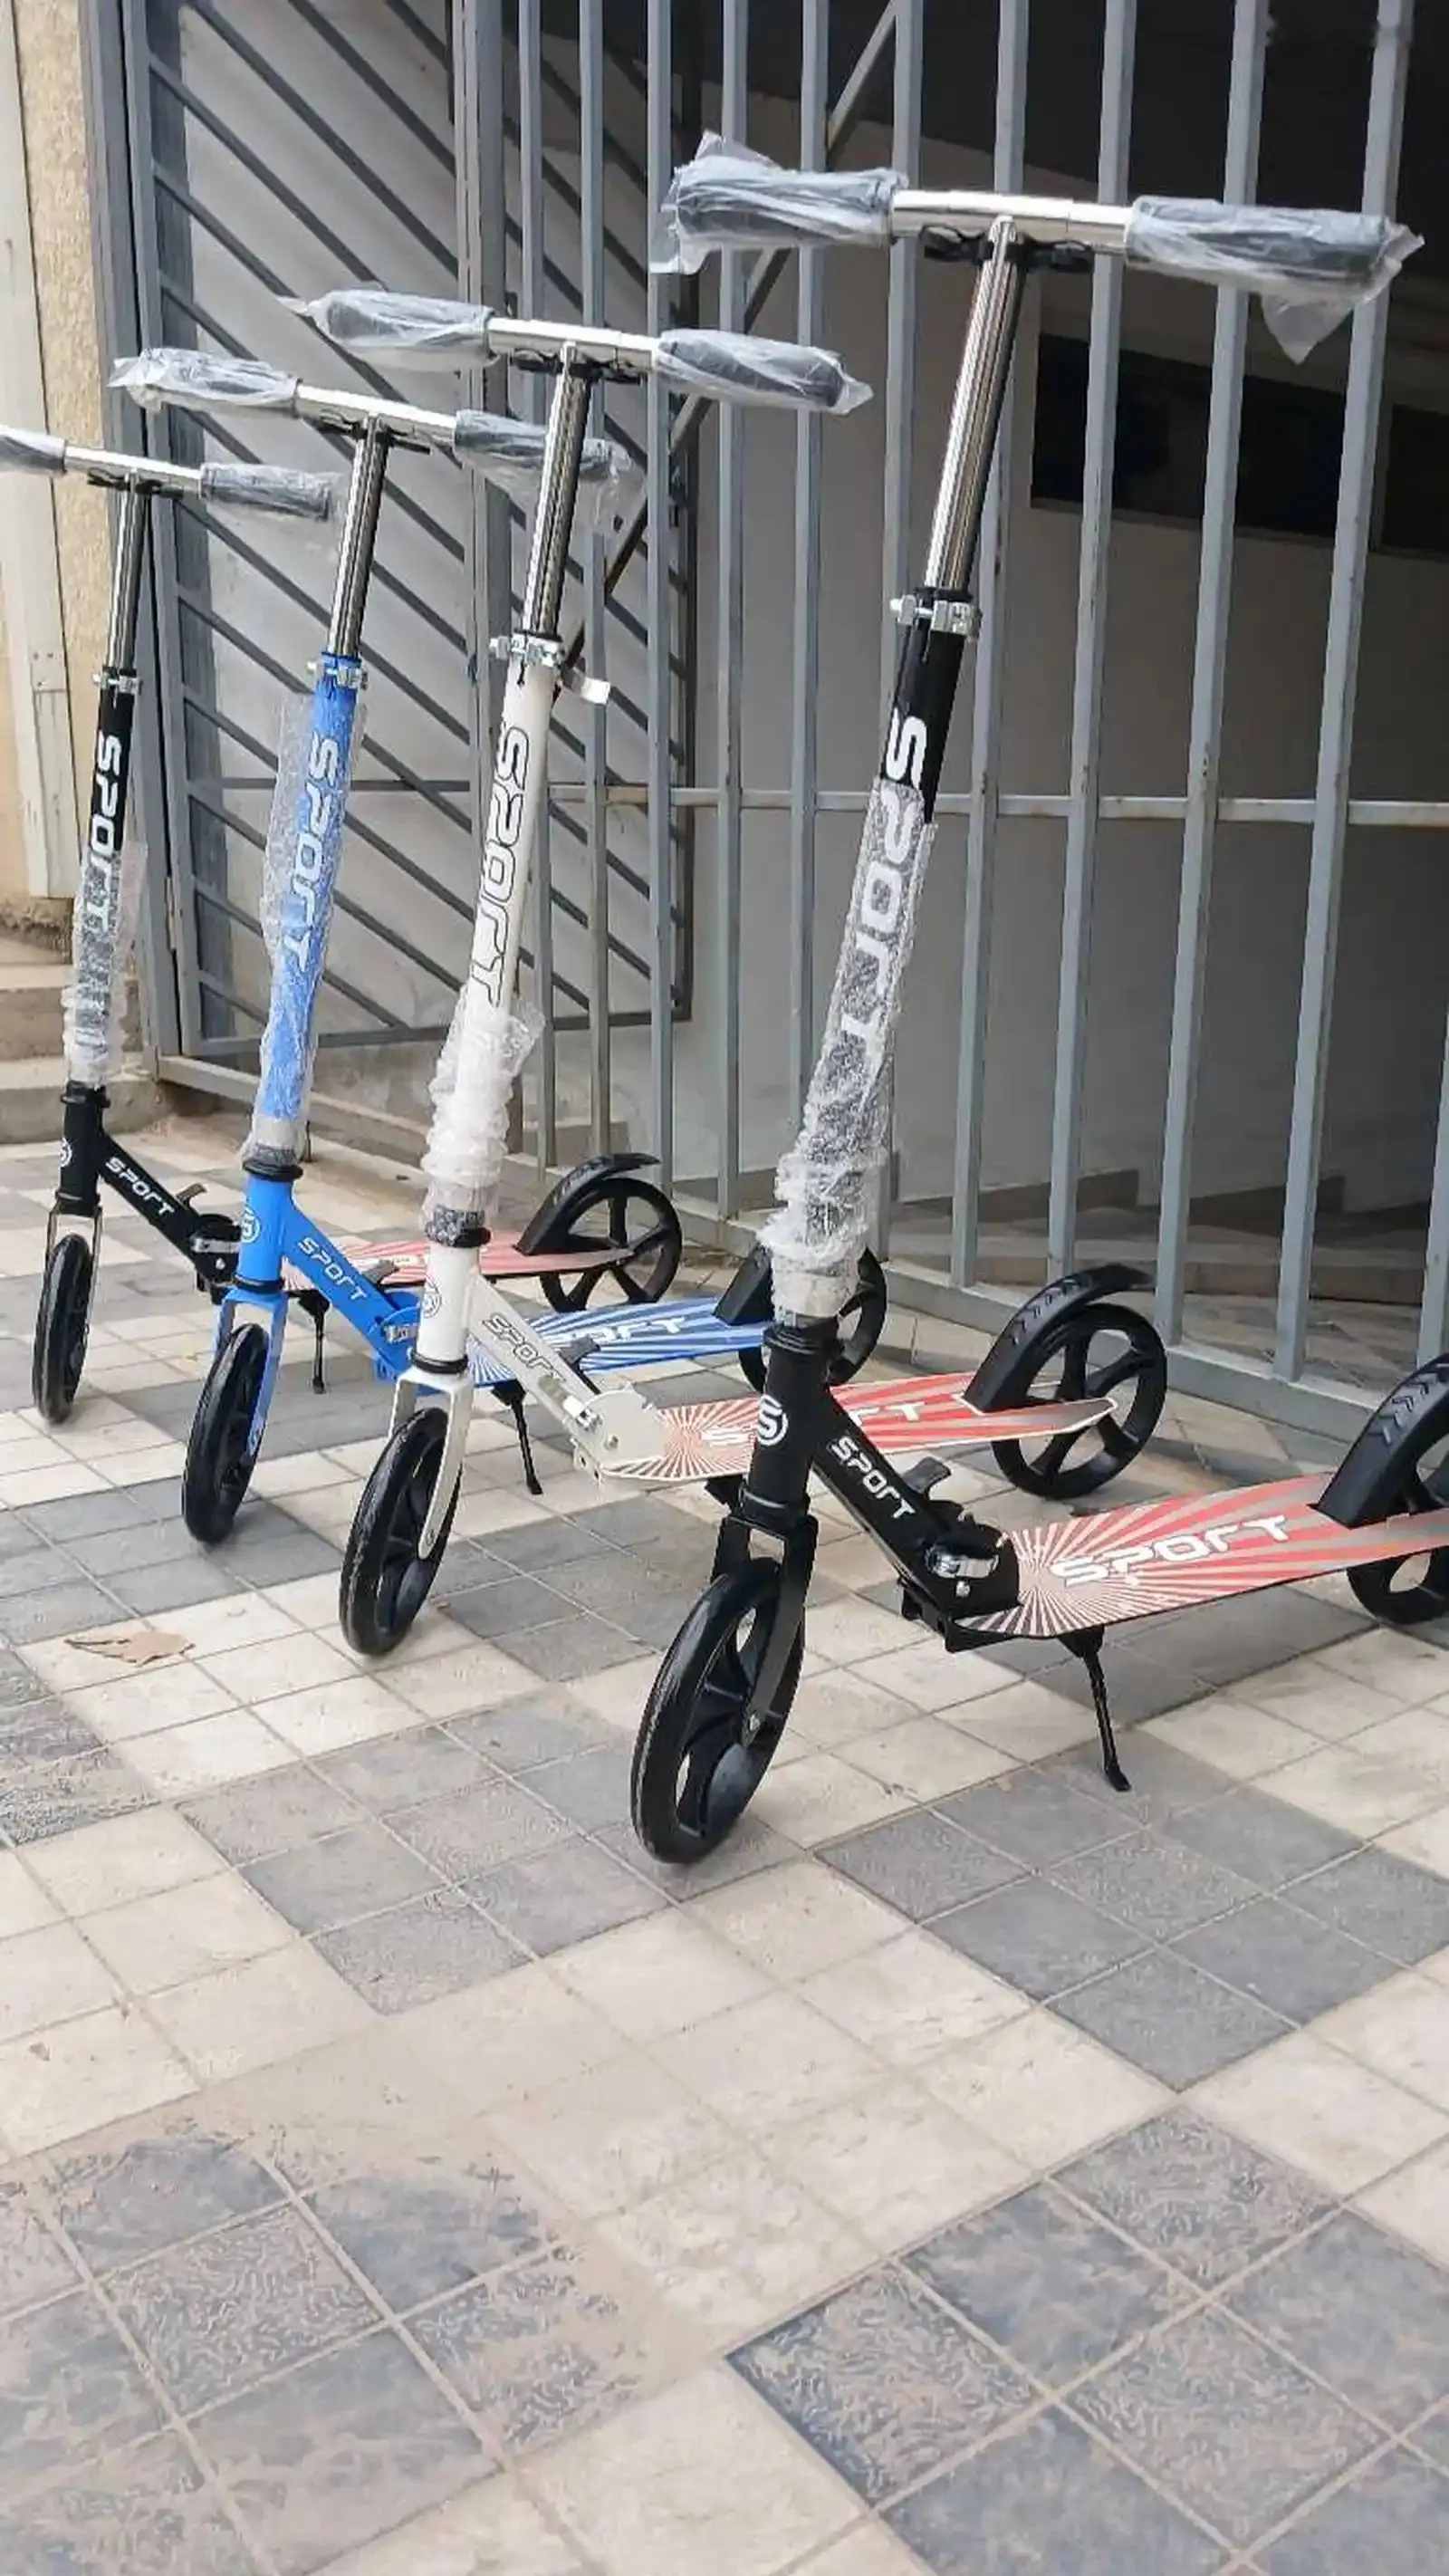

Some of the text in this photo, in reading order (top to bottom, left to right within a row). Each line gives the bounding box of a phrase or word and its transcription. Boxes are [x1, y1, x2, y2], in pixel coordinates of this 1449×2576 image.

[280, 732, 339, 973] SPORT
[469, 724, 530, 1008] SPORT
[105, 1156, 175, 1216] SPORT
[296, 1236, 368, 1301] SPORT
[826, 1435, 916, 1519] SPORT
[1050, 1514, 1289, 1586] SPORT
